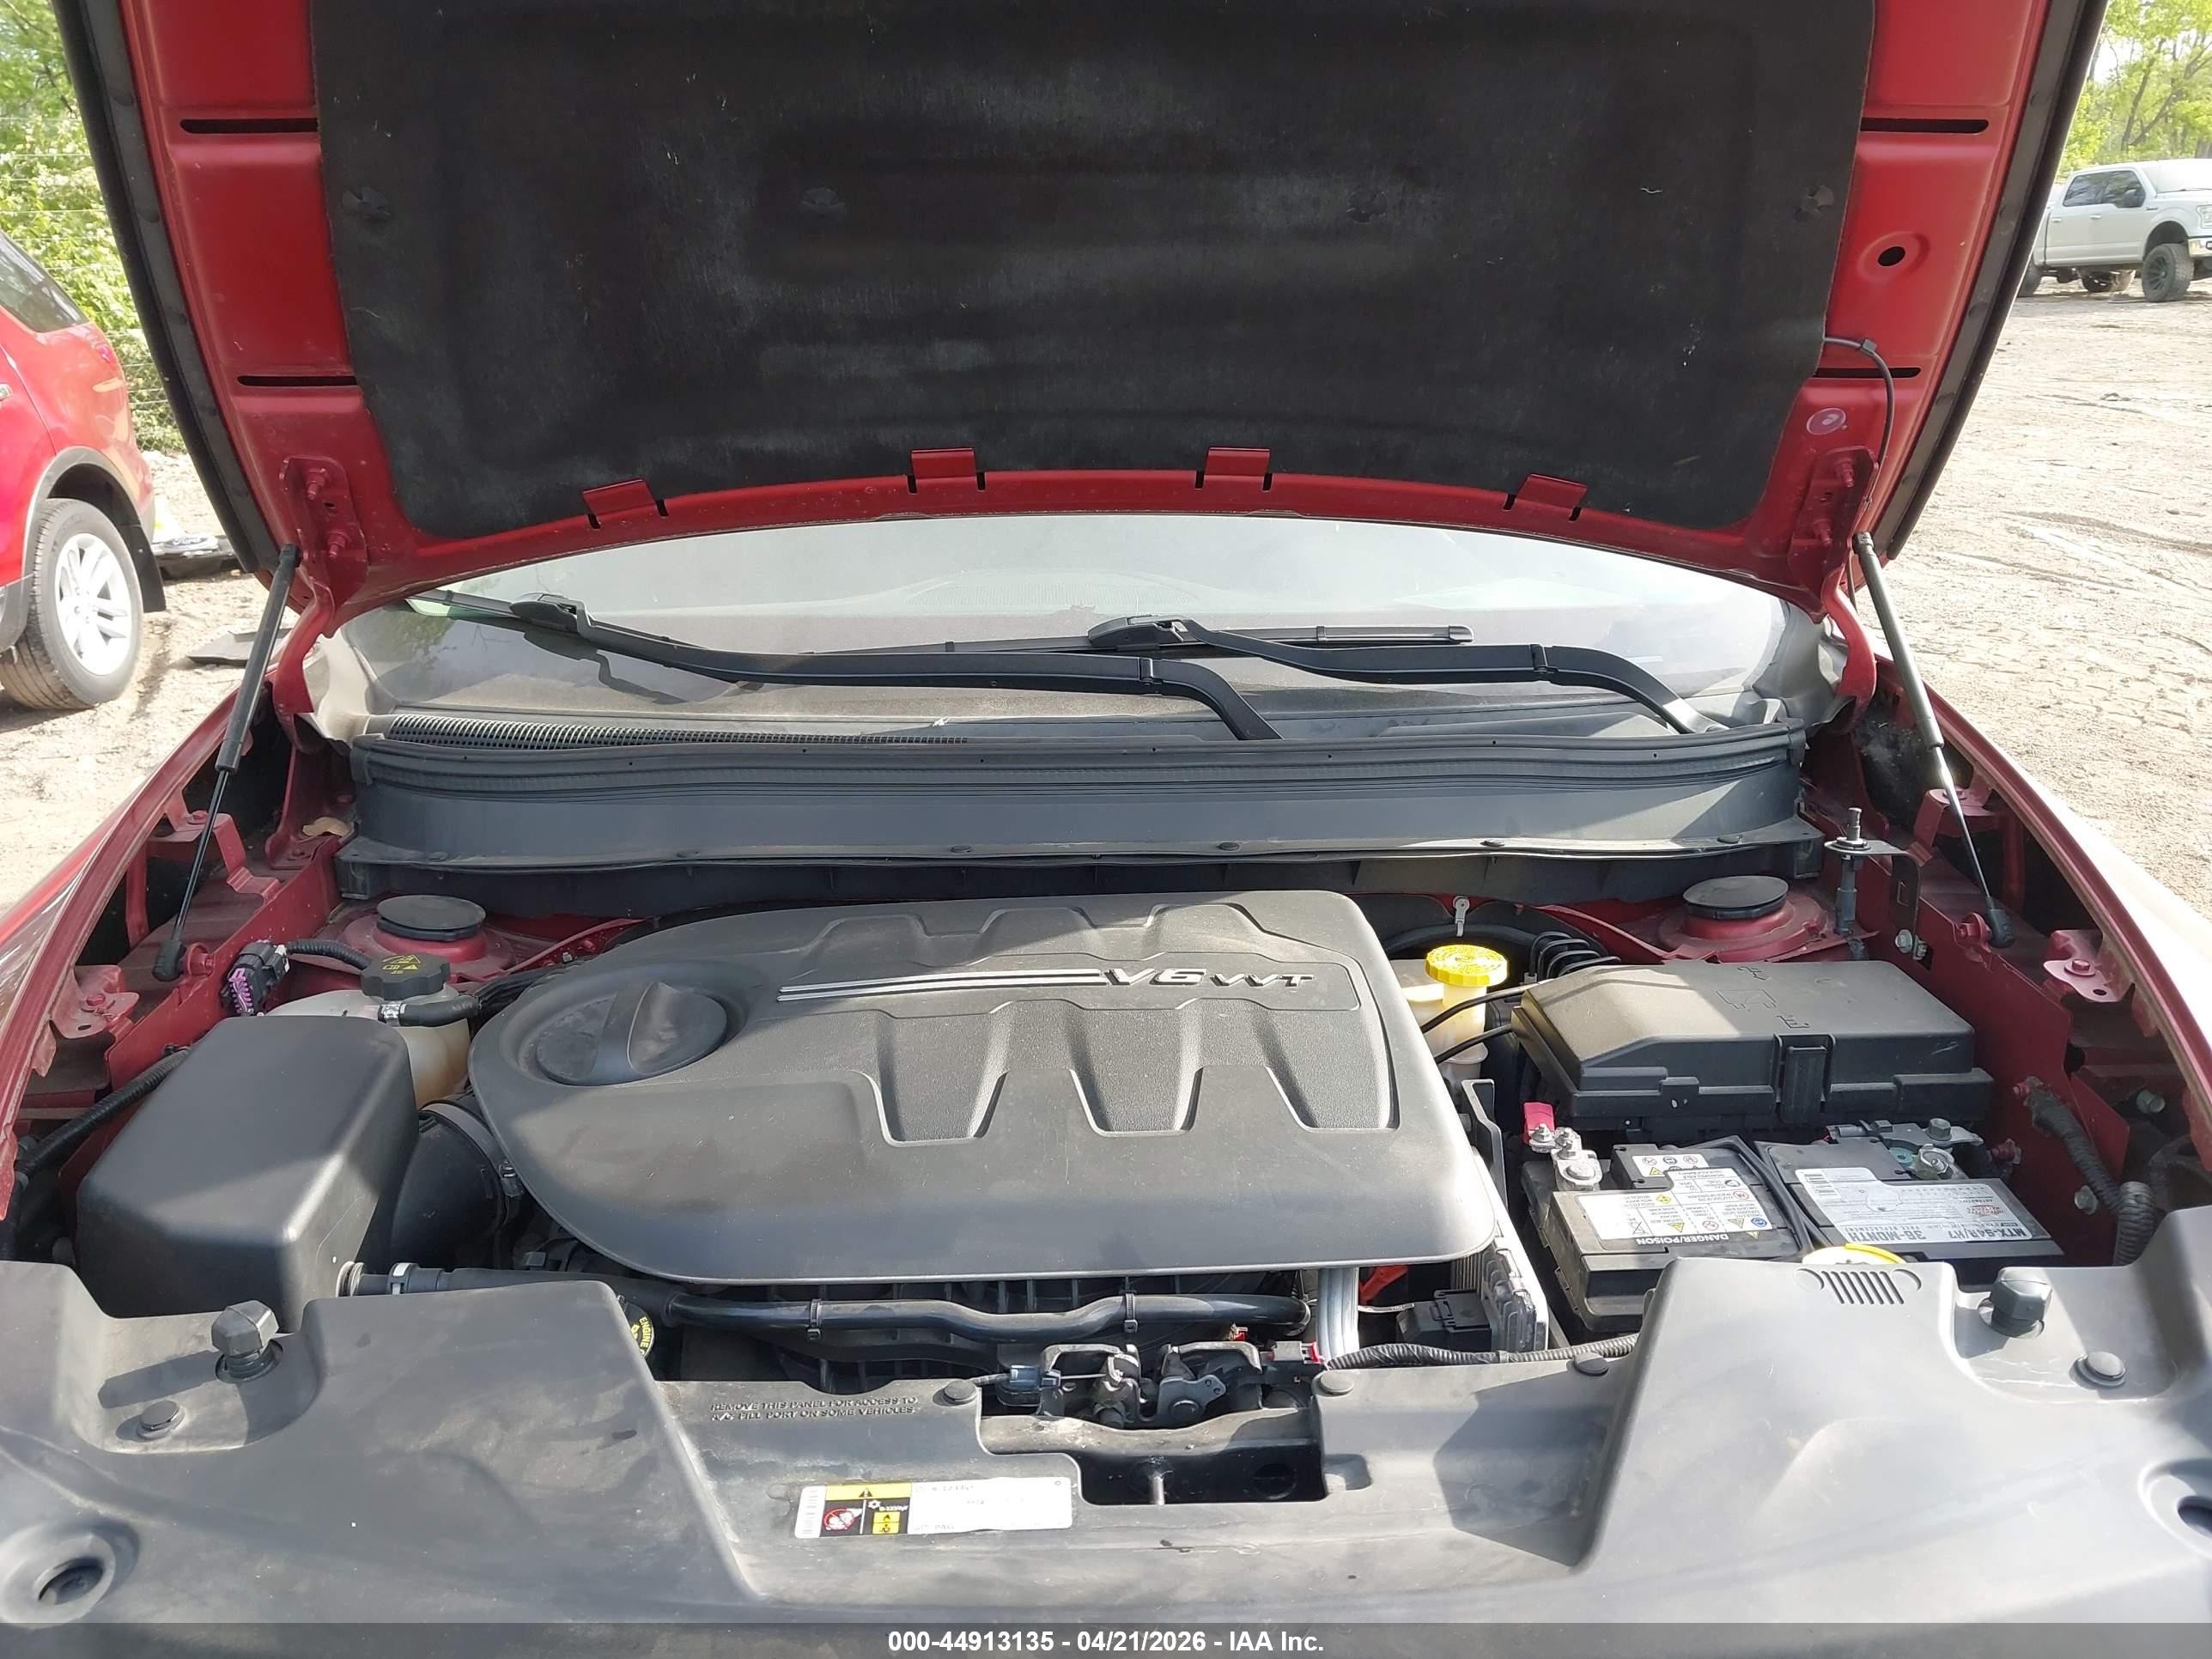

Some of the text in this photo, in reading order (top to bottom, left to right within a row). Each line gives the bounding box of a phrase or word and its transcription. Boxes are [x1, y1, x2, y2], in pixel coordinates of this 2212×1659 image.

[1104, 968, 1207, 987] V6
[1636, 1233, 1729, 1244] DANGER/POISON
[1847, 1230, 1927, 1242] 36-MONTH
[638, 1316, 652, 1348] ENGINE
[710, 1395, 917, 1411] REMOVE THIS PANEL FOR ACCESS TO
[738, 1410, 761, 1420] FILL
[765, 1410, 797, 1419] PORT
[799, 1409, 818, 1419] ON
[820, 1408, 856, 1418] SOME
[857, 1406, 915, 1416] VEHICLES
